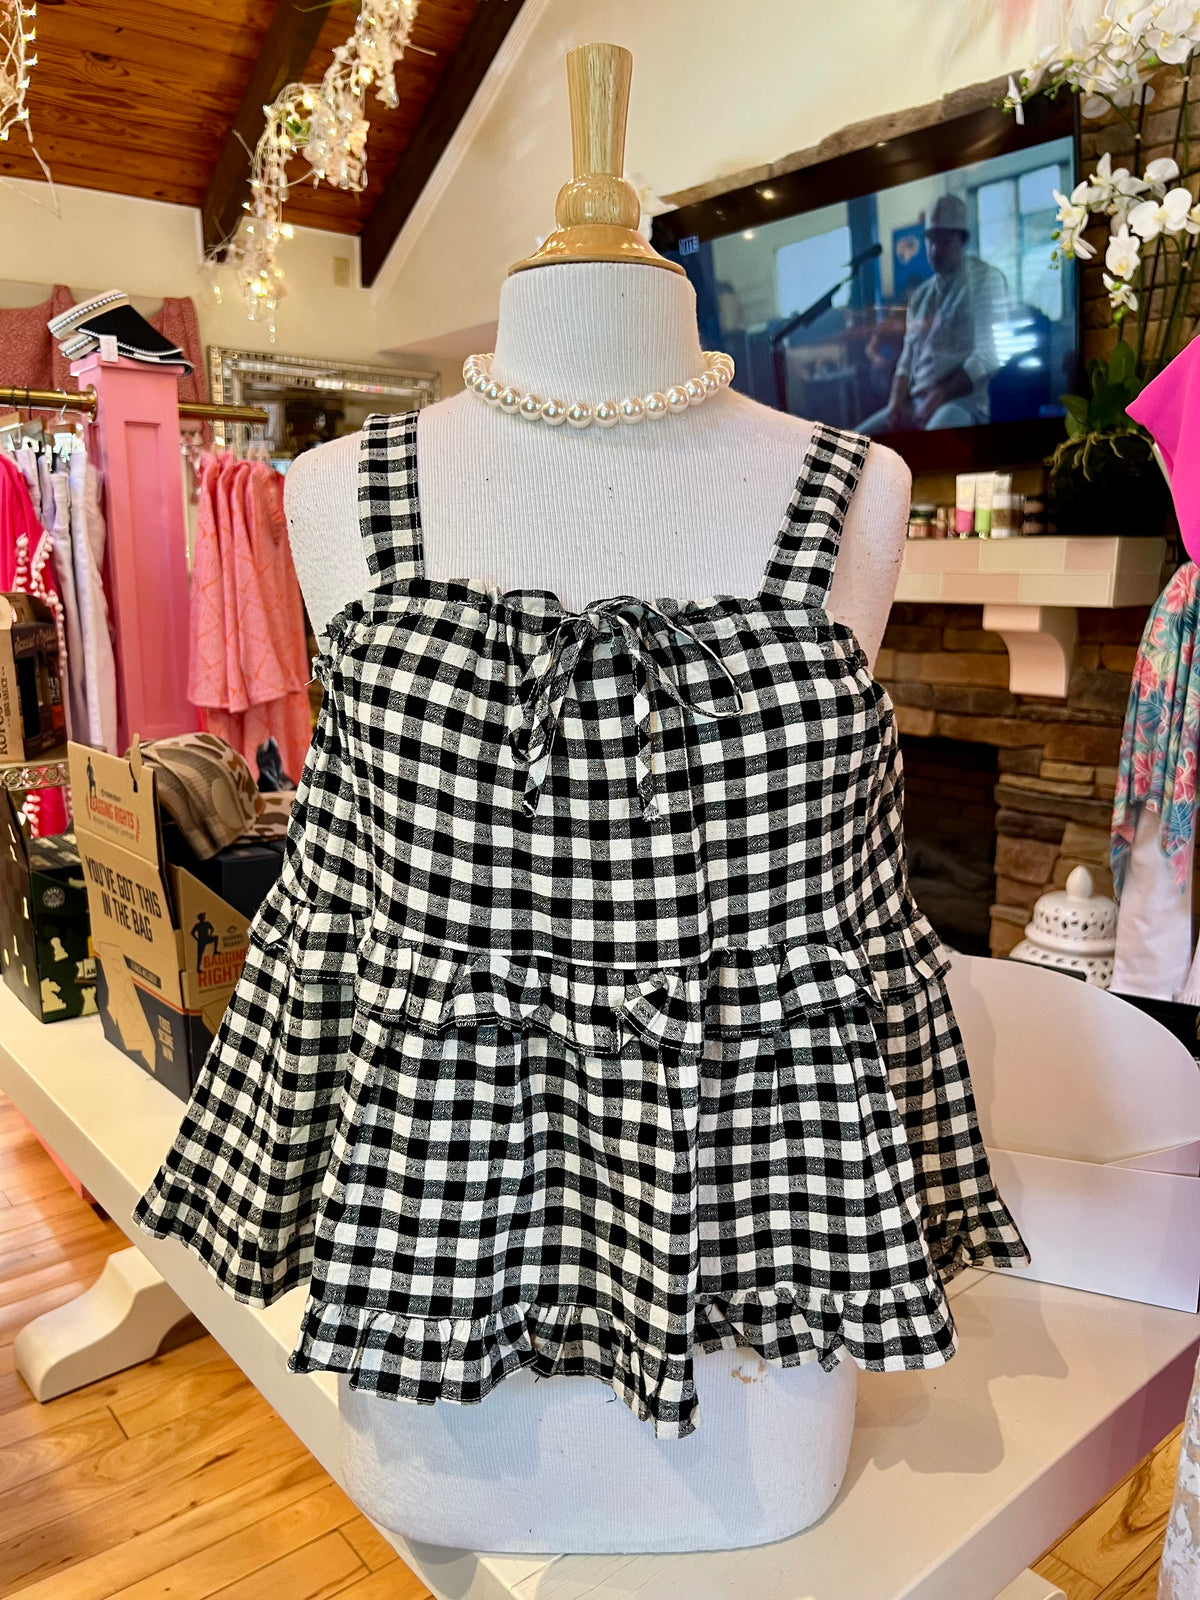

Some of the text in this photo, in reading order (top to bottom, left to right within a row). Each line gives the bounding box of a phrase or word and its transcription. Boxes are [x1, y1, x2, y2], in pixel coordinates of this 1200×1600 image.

[85, 855, 162, 919] YOU'VE GOT THIS
[101, 890, 113, 919] IN
[112, 897, 132, 931] THE
[131, 908, 154, 943] BAG
[198, 963, 242, 989] RIGHT
[203, 948, 247, 969] BAGGIN
